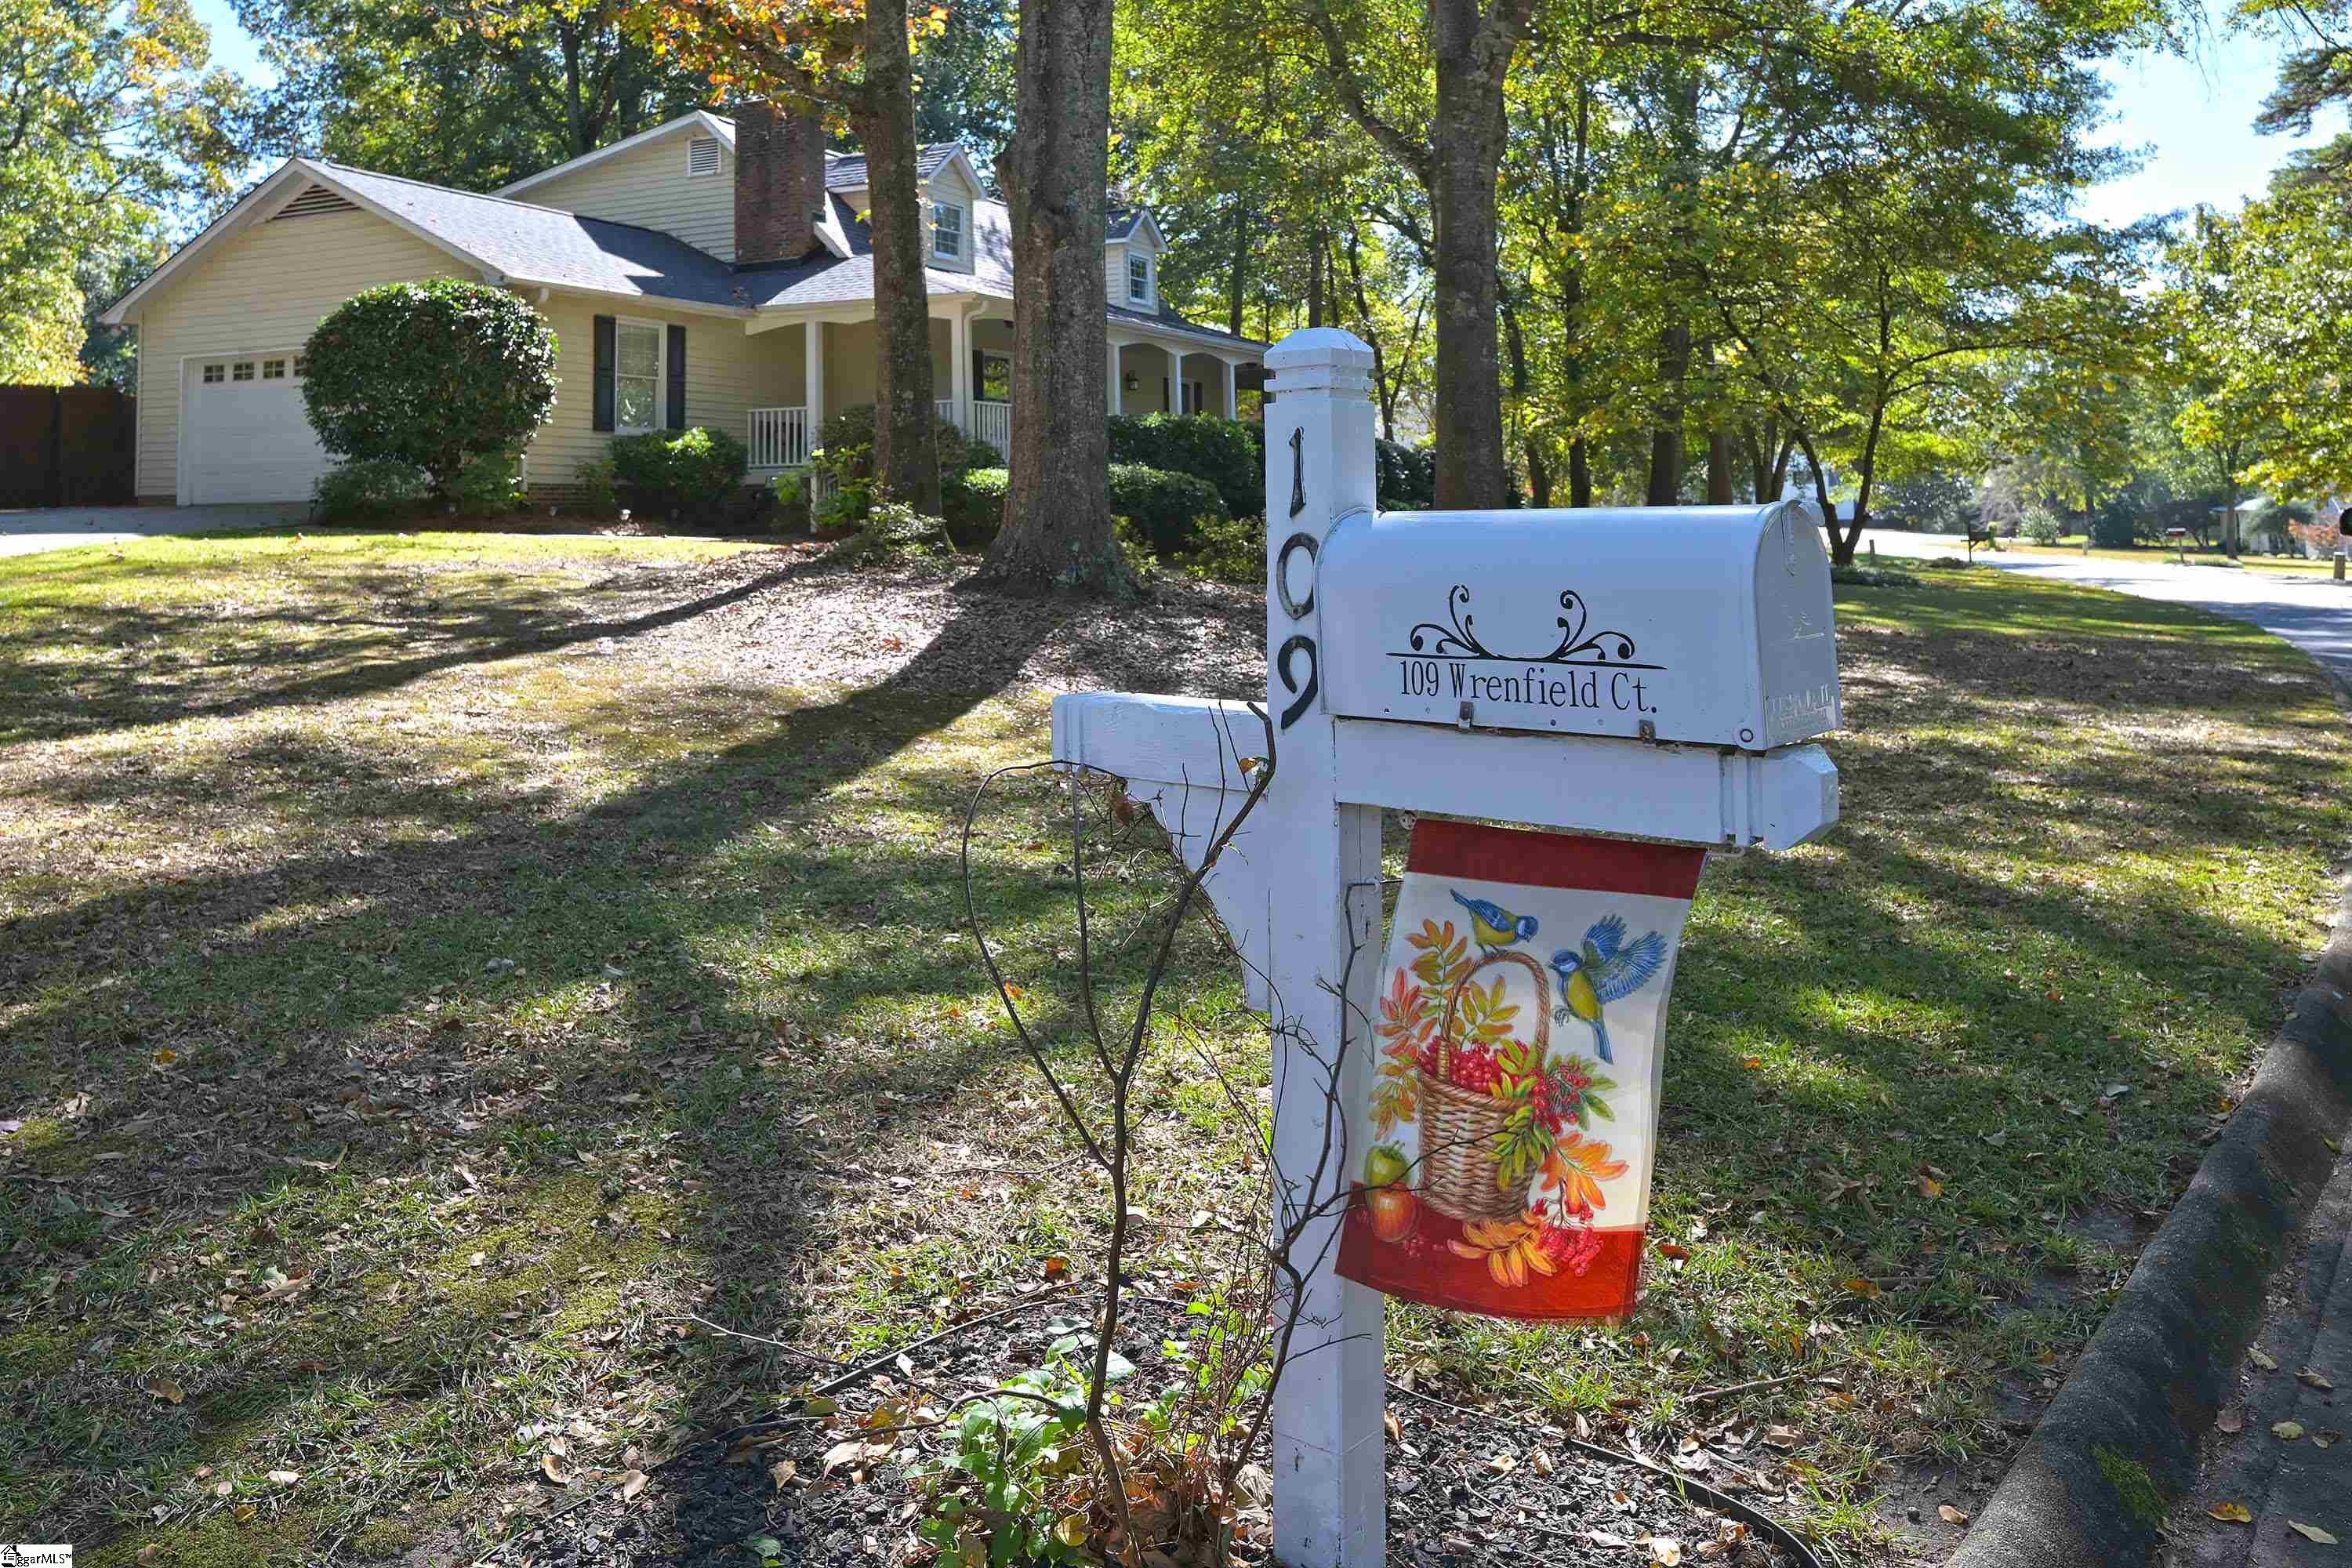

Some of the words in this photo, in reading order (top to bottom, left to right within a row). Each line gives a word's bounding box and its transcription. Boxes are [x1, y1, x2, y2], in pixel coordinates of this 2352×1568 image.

[1276, 426, 1320, 730] 109
[1400, 659, 1439, 697] 109
[1449, 662, 1600, 709] Wrenfield
[1611, 672, 1657, 713] Ct.
